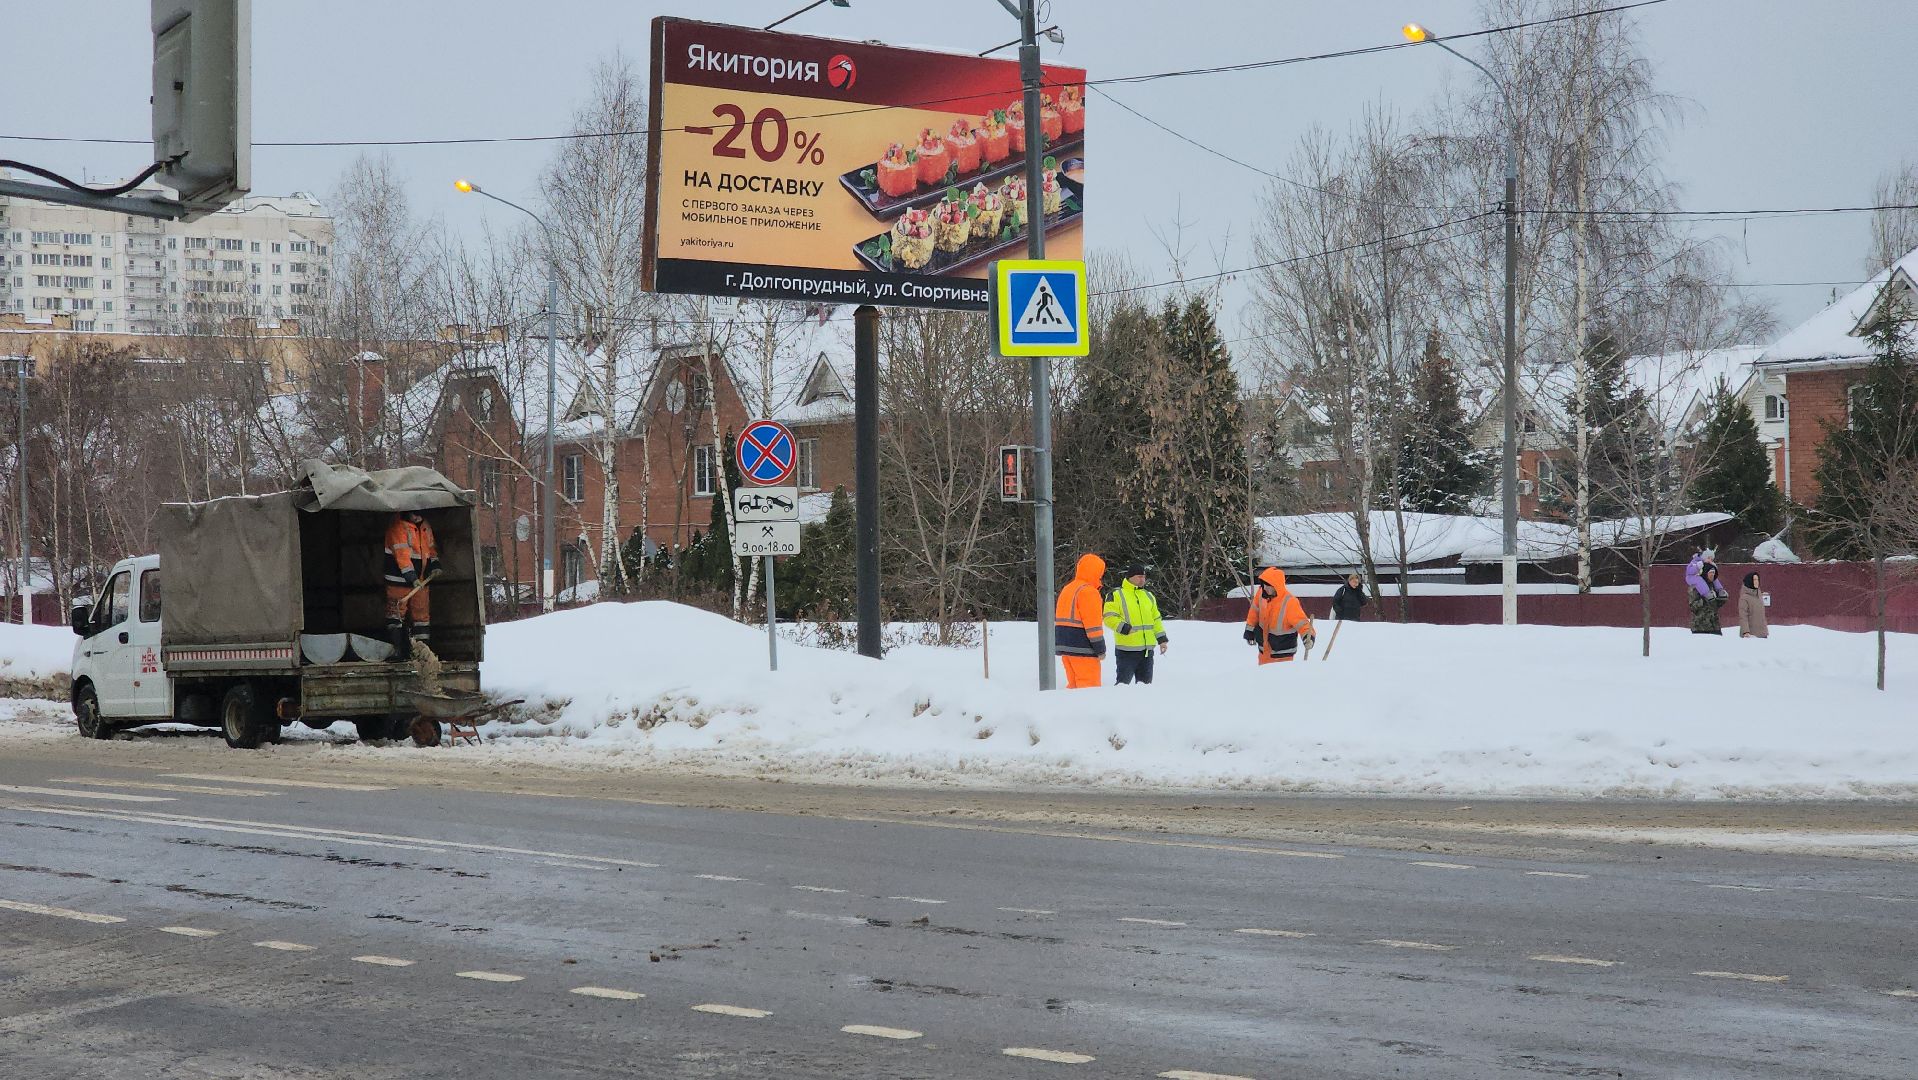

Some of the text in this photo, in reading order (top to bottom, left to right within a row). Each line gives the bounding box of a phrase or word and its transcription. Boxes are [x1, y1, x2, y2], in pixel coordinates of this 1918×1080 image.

[687, 44, 819, 83] Якитория
[684, 170, 824, 198] НА ДОСТАВКУ
[682, 199, 814, 218] С ПЕРВОГО ЗАКАЗА ЧЕРЕЗ
[682, 212, 822, 231] МОБИЛЬНОЕ ПРИЛОЖЕНИЕ
[680, 237, 734, 249] yakitoriya.ru
[725, 272, 989, 302] г. Долгопрудный, ул. Спортивна
[742, 541, 794, 553] 9.00-18.00
